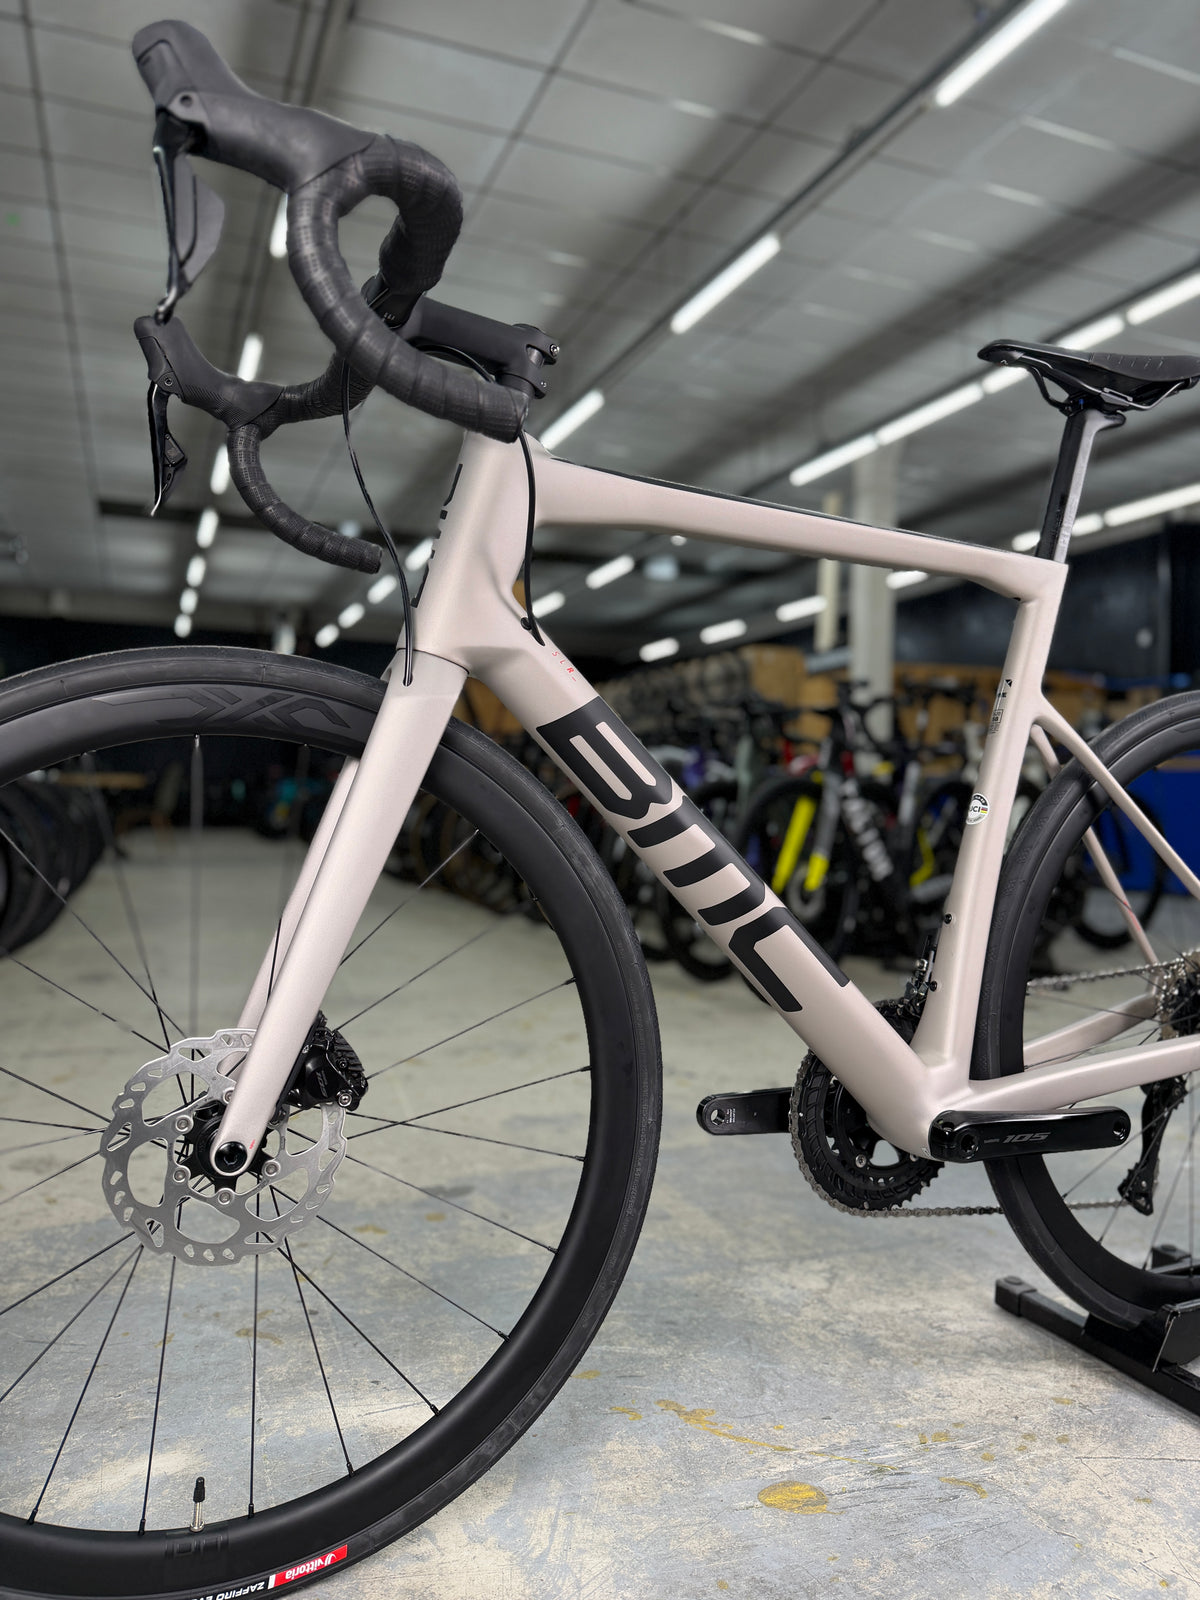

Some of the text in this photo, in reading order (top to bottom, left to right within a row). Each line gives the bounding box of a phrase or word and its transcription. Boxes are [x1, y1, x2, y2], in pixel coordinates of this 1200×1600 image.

[536, 695, 851, 1012] BMC
[1002, 1131, 1051, 1144] 105
[215, 1581, 265, 1600] ZAFFIRO
